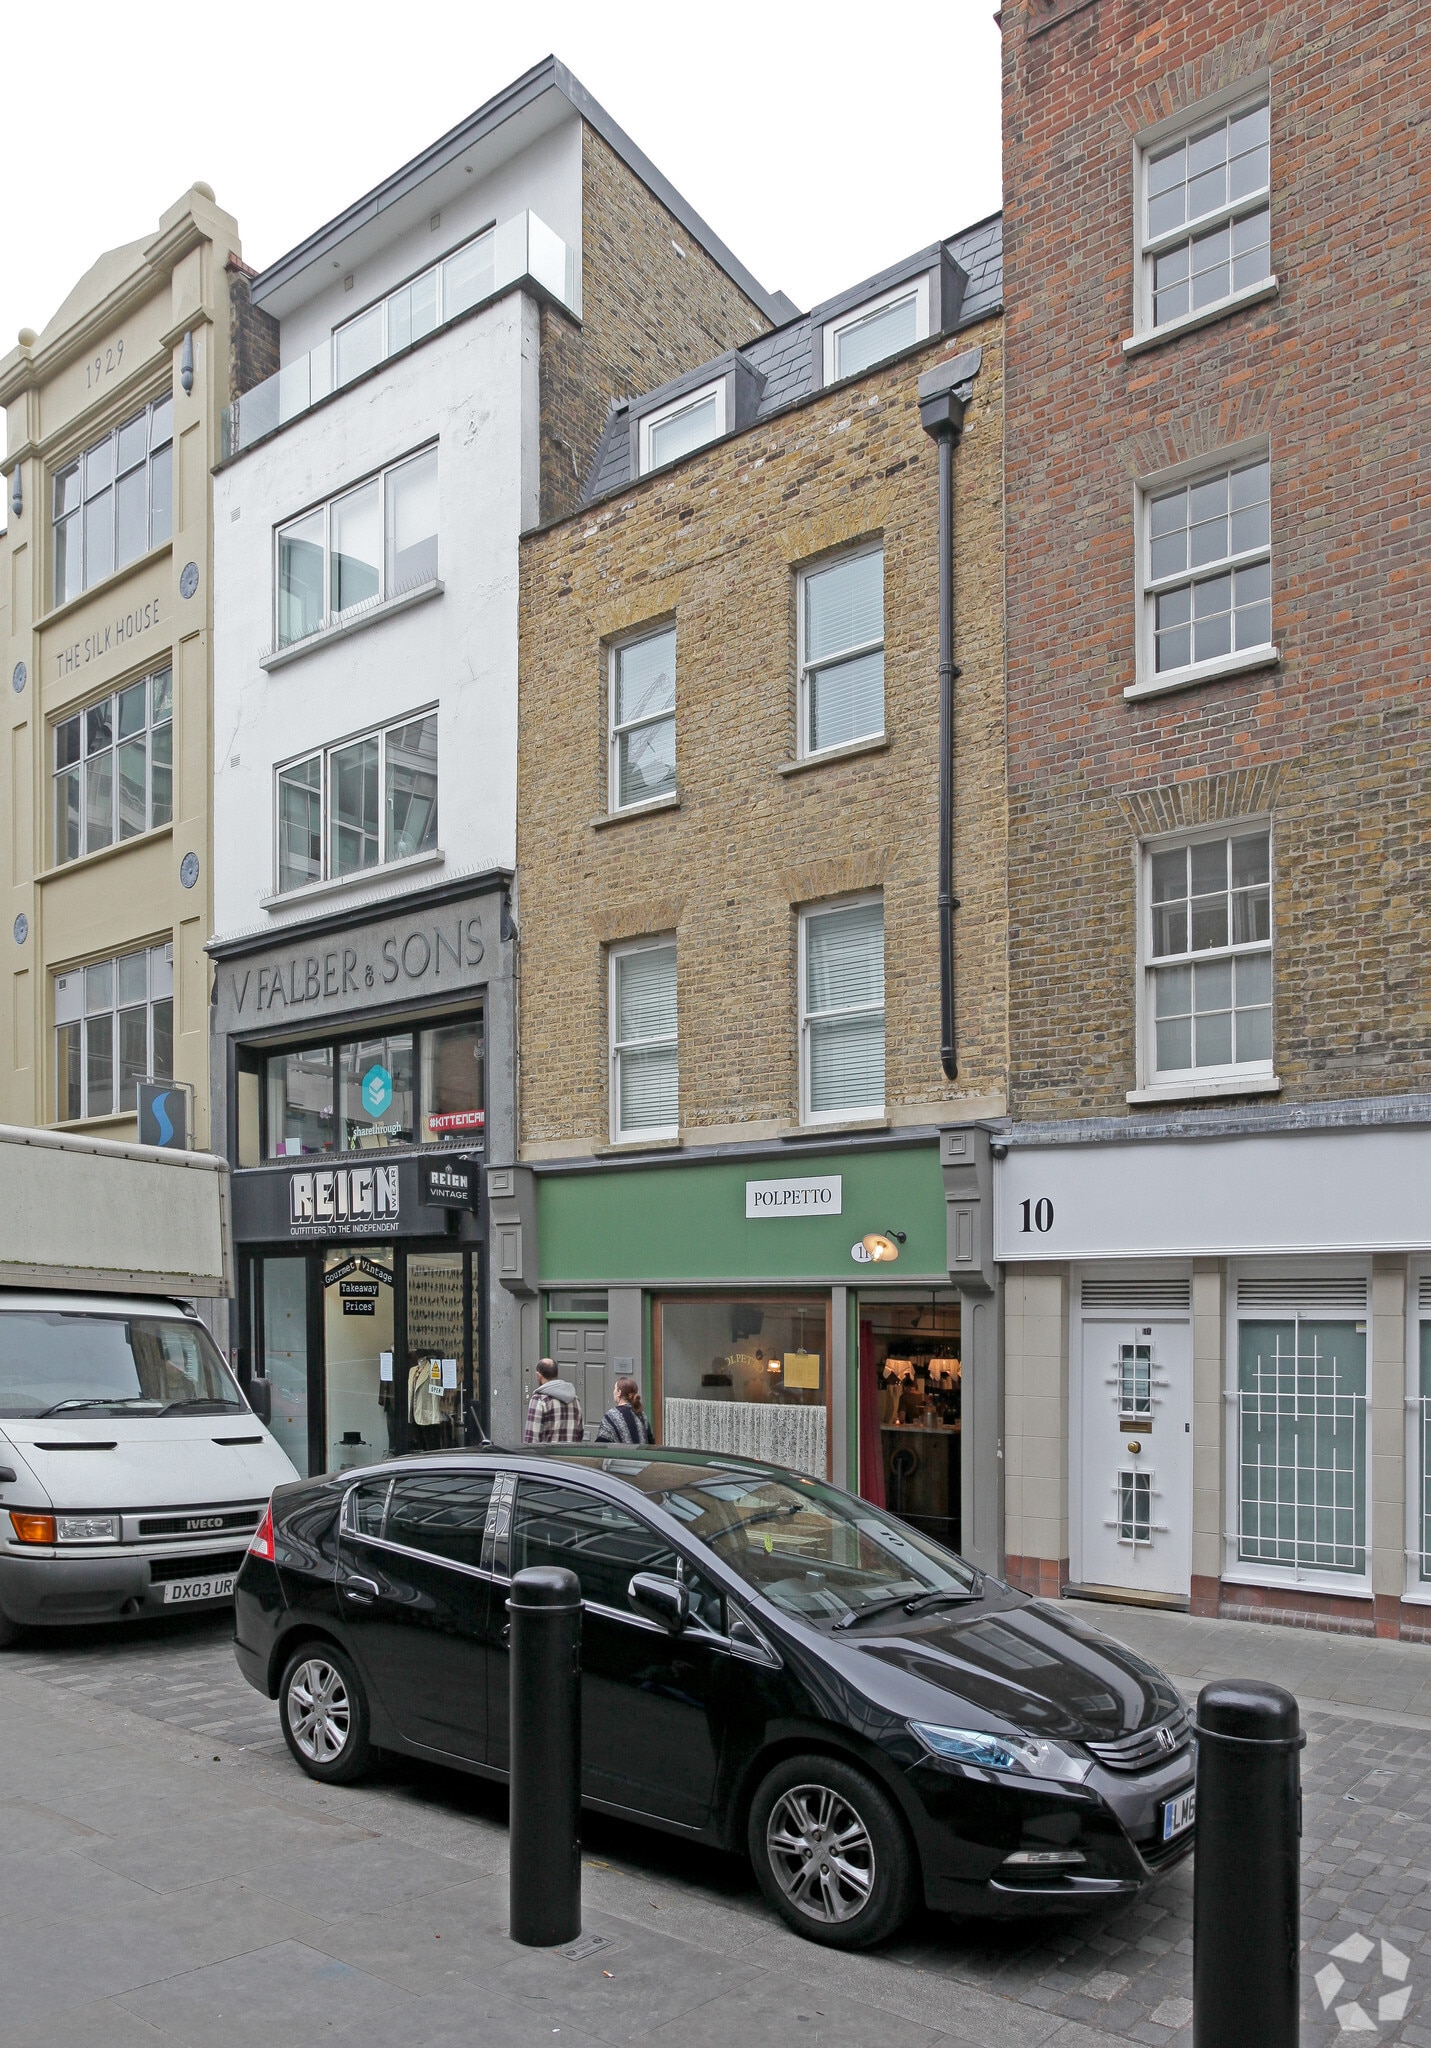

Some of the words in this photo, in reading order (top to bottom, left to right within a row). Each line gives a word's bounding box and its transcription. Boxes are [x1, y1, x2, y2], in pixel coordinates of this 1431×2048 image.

[86, 339, 124, 389] 1929
[56, 643, 81, 678] THE
[84, 625, 112, 663] SILK
[115, 598, 160, 646] HOUSE
[364, 964, 375, 988] &
[381, 915, 485, 984] SONS
[353, 1121, 402, 1138] sharethrough
[430, 1171, 468, 1189] REIGN
[290, 1166, 399, 1225] REIGN
[430, 1188, 468, 1200] VINTAGE
[753, 1188, 832, 1207] POLPETTO
[1018, 1197, 1055, 1233] 10
[290, 1225, 327, 1236] OUTFITTERS
[328, 1225, 337, 1234] TO
[339, 1224, 351, 1234] THE
[352, 1222, 400, 1233] INDEPENDENT
[324, 1261, 355, 1284] Gourmet
[361, 1260, 393, 1283] Vintage
[341, 1283, 378, 1295] Takeaway
[186, 1518, 223, 1530] IVECO
[172, 1582, 211, 1600] DX03
[214, 1579, 235, 1595] UR
[1173, 1793, 1196, 1831] LM6
